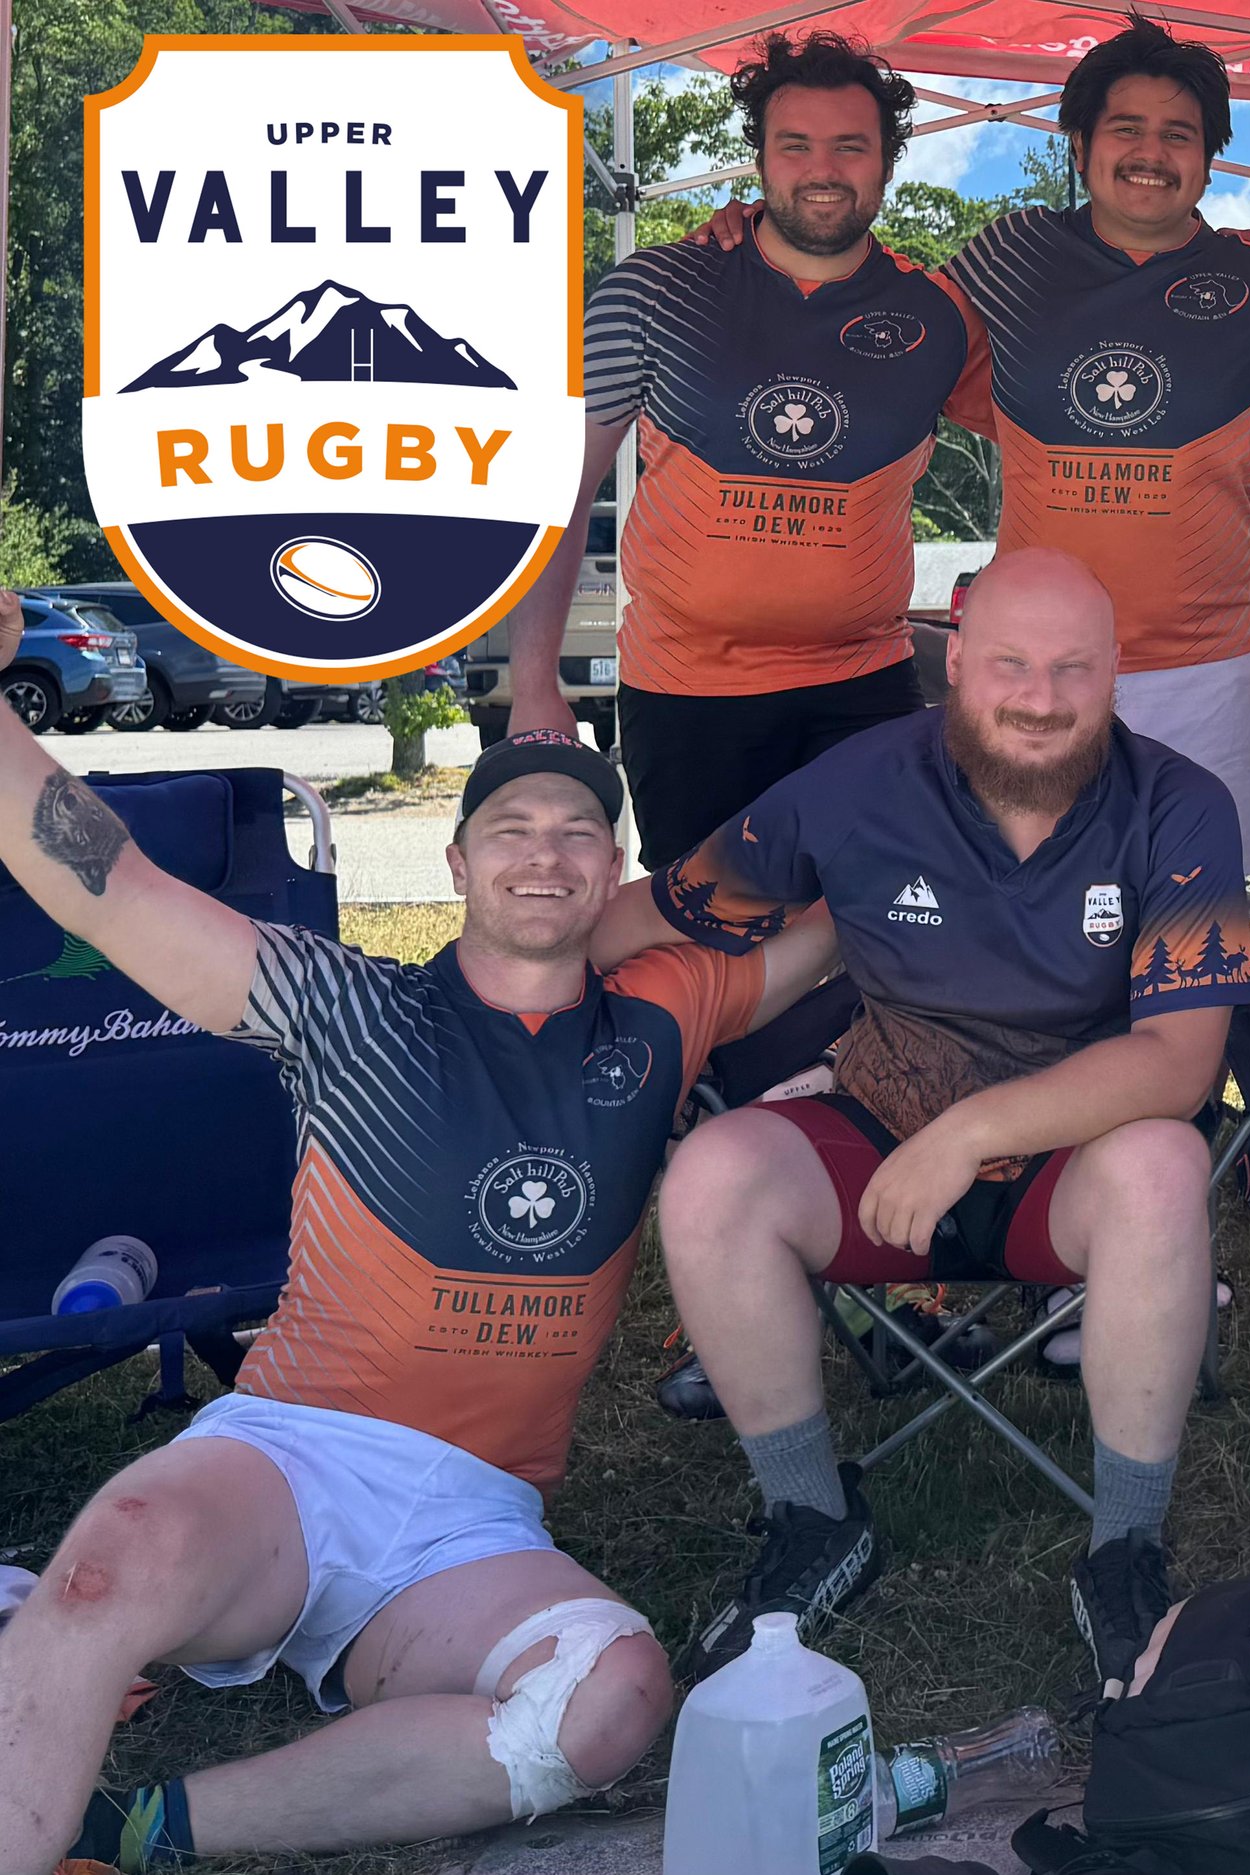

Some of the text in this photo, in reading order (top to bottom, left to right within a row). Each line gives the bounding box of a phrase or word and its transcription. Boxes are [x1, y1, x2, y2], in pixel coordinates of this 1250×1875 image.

[1099, 340, 1143, 351] Newport
[776, 373, 821, 386] Newport
[1081, 356, 1153, 384] Salt hill Pub
[759, 389, 832, 419] Salt hill Pub
[1048, 460, 1172, 482] TULLAMORE
[719, 489, 847, 516] TULLAMORE
[1088, 896, 1120, 906] VALLEY
[887, 908, 943, 926] credo
[1090, 920, 1120, 928] RUGBY
[0, 1008, 205, 1057] ommy Baha
[518, 1141, 565, 1157] Newport
[493, 1162, 576, 1197] Salt hill Pub
[432, 1287, 586, 1317] TULLAMORE
[476, 1322, 538, 1345] D.E.W.
[829, 1740, 864, 1784] Poland
[832, 1756, 866, 1800] Spring
